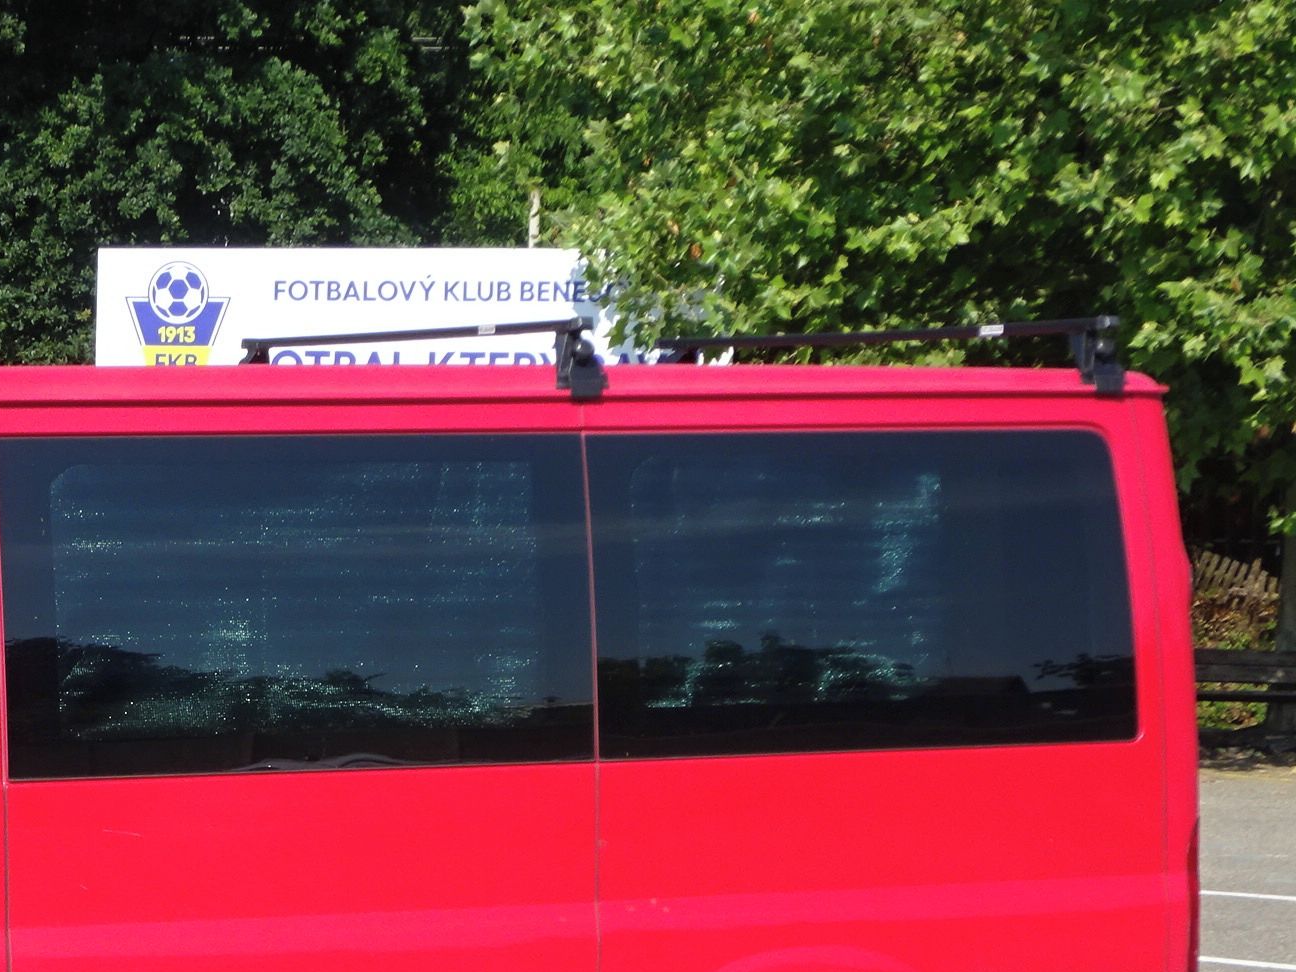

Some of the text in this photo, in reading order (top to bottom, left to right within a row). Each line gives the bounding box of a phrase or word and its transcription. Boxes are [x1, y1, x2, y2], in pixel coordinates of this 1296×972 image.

[273, 274, 436, 302] FOTBALOVÝ
[443, 280, 512, 302] KLUB
[157, 325, 196, 343] 1913
